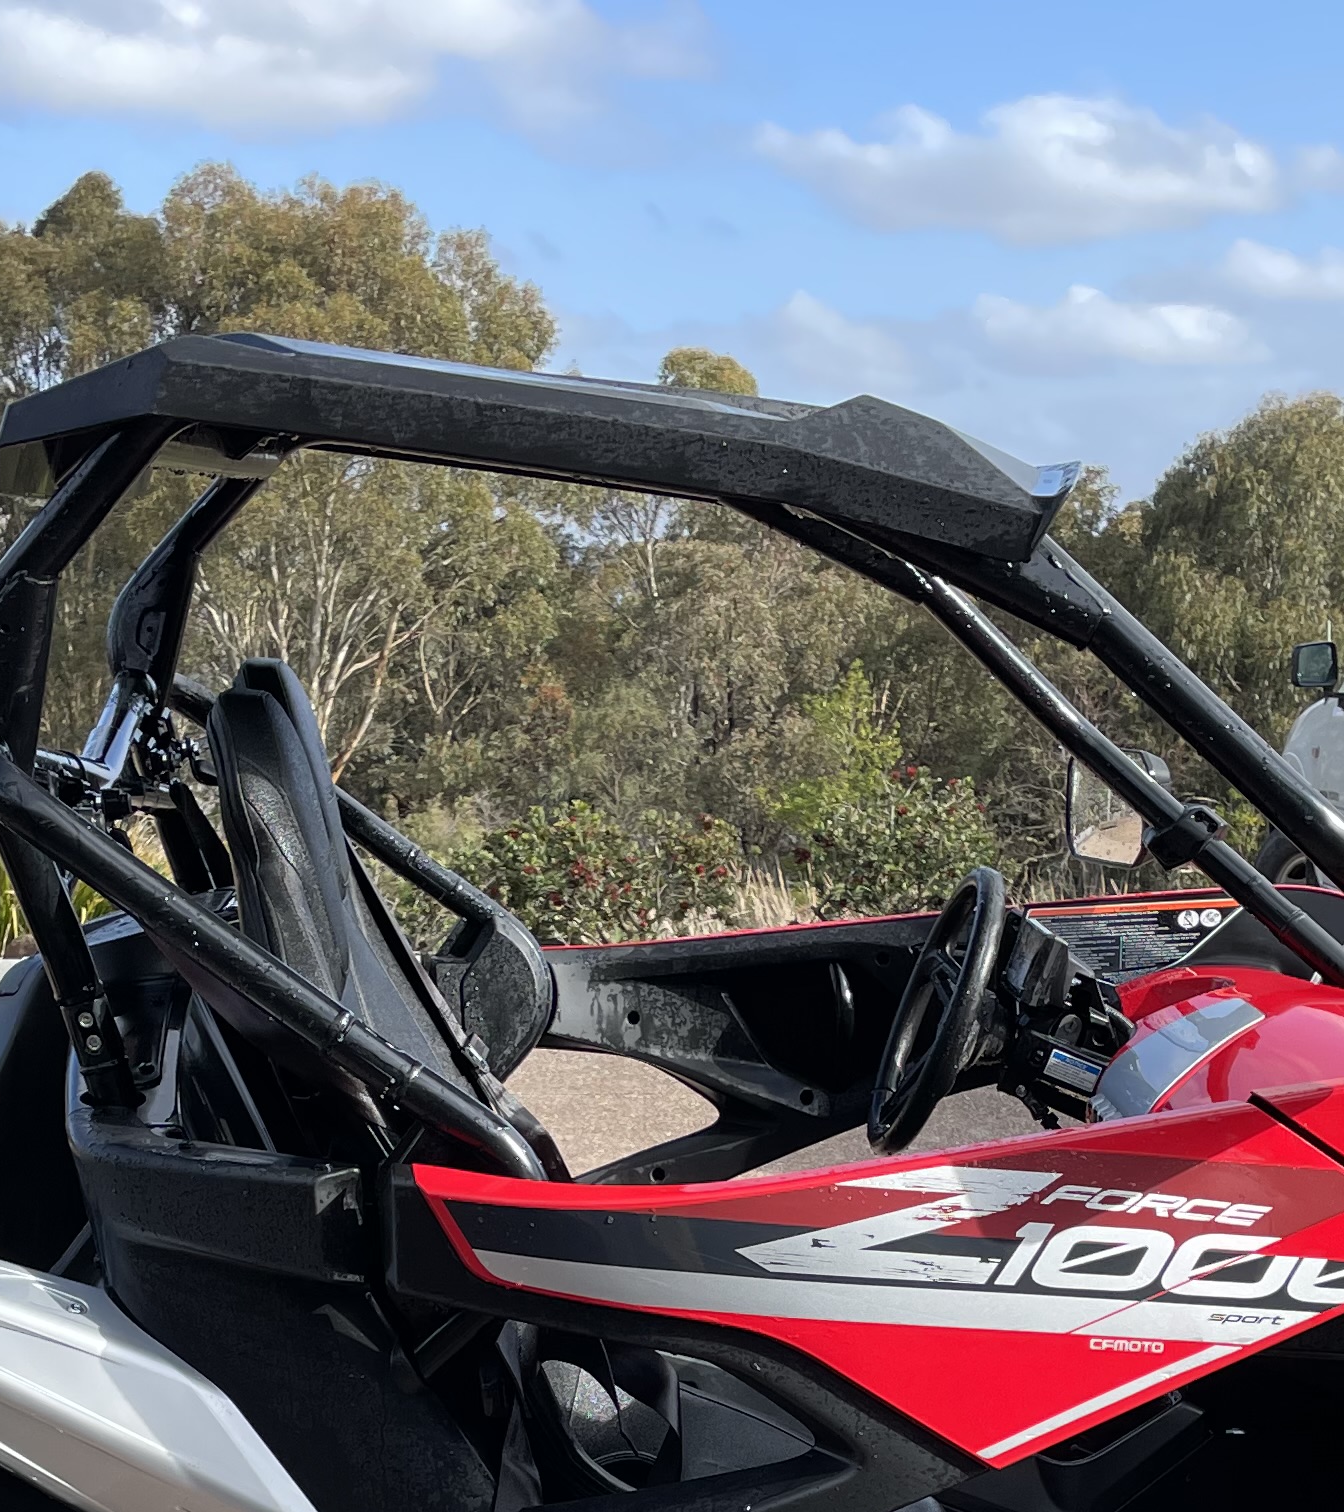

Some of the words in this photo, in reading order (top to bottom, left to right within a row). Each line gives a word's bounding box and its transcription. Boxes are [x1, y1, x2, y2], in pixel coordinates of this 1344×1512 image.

[1041, 1184, 1274, 1227] FORCE
[1207, 1313, 1286, 1326] sport
[1089, 1338, 1165, 1354] CFMOTO
